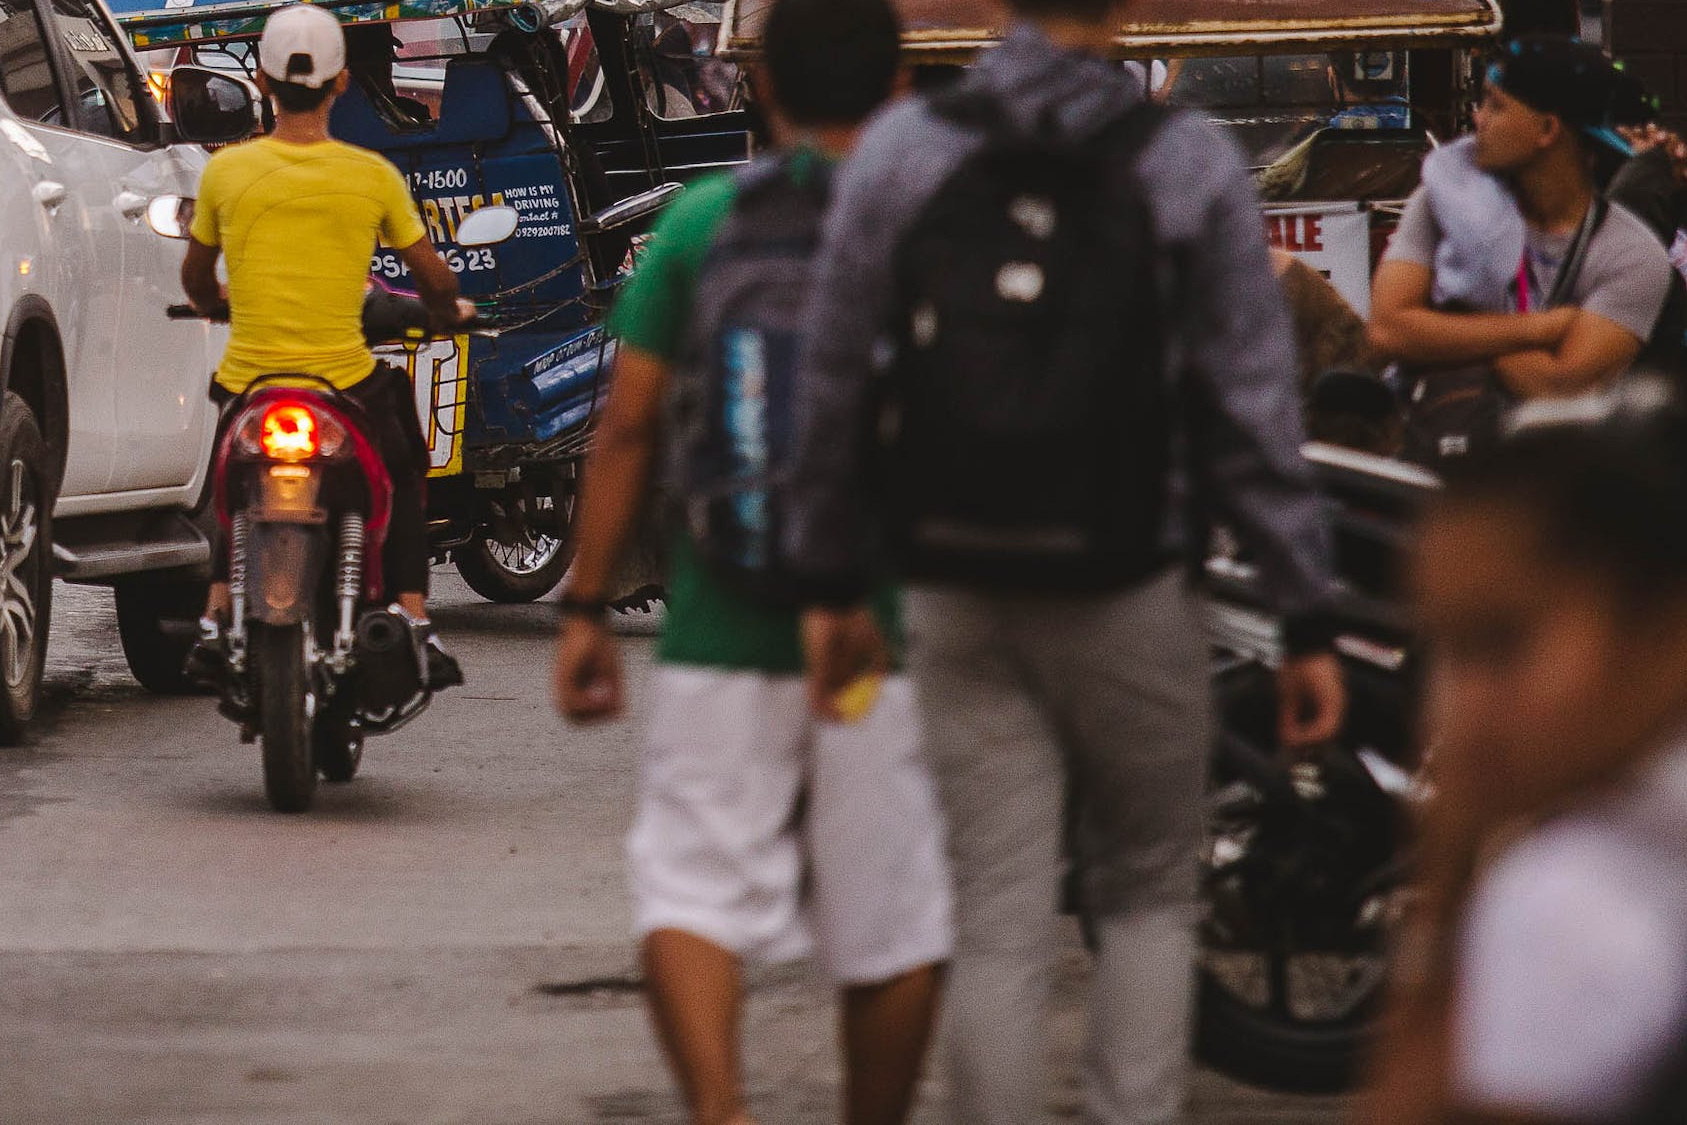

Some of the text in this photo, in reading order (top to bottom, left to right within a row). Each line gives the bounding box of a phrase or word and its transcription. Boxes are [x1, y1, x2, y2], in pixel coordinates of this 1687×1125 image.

[505, 184, 554, 199] HOW IS MY
[514, 198, 560, 211] DRIVING
[518, 211, 549, 223] ontact
[466, 248, 496, 271] 23
